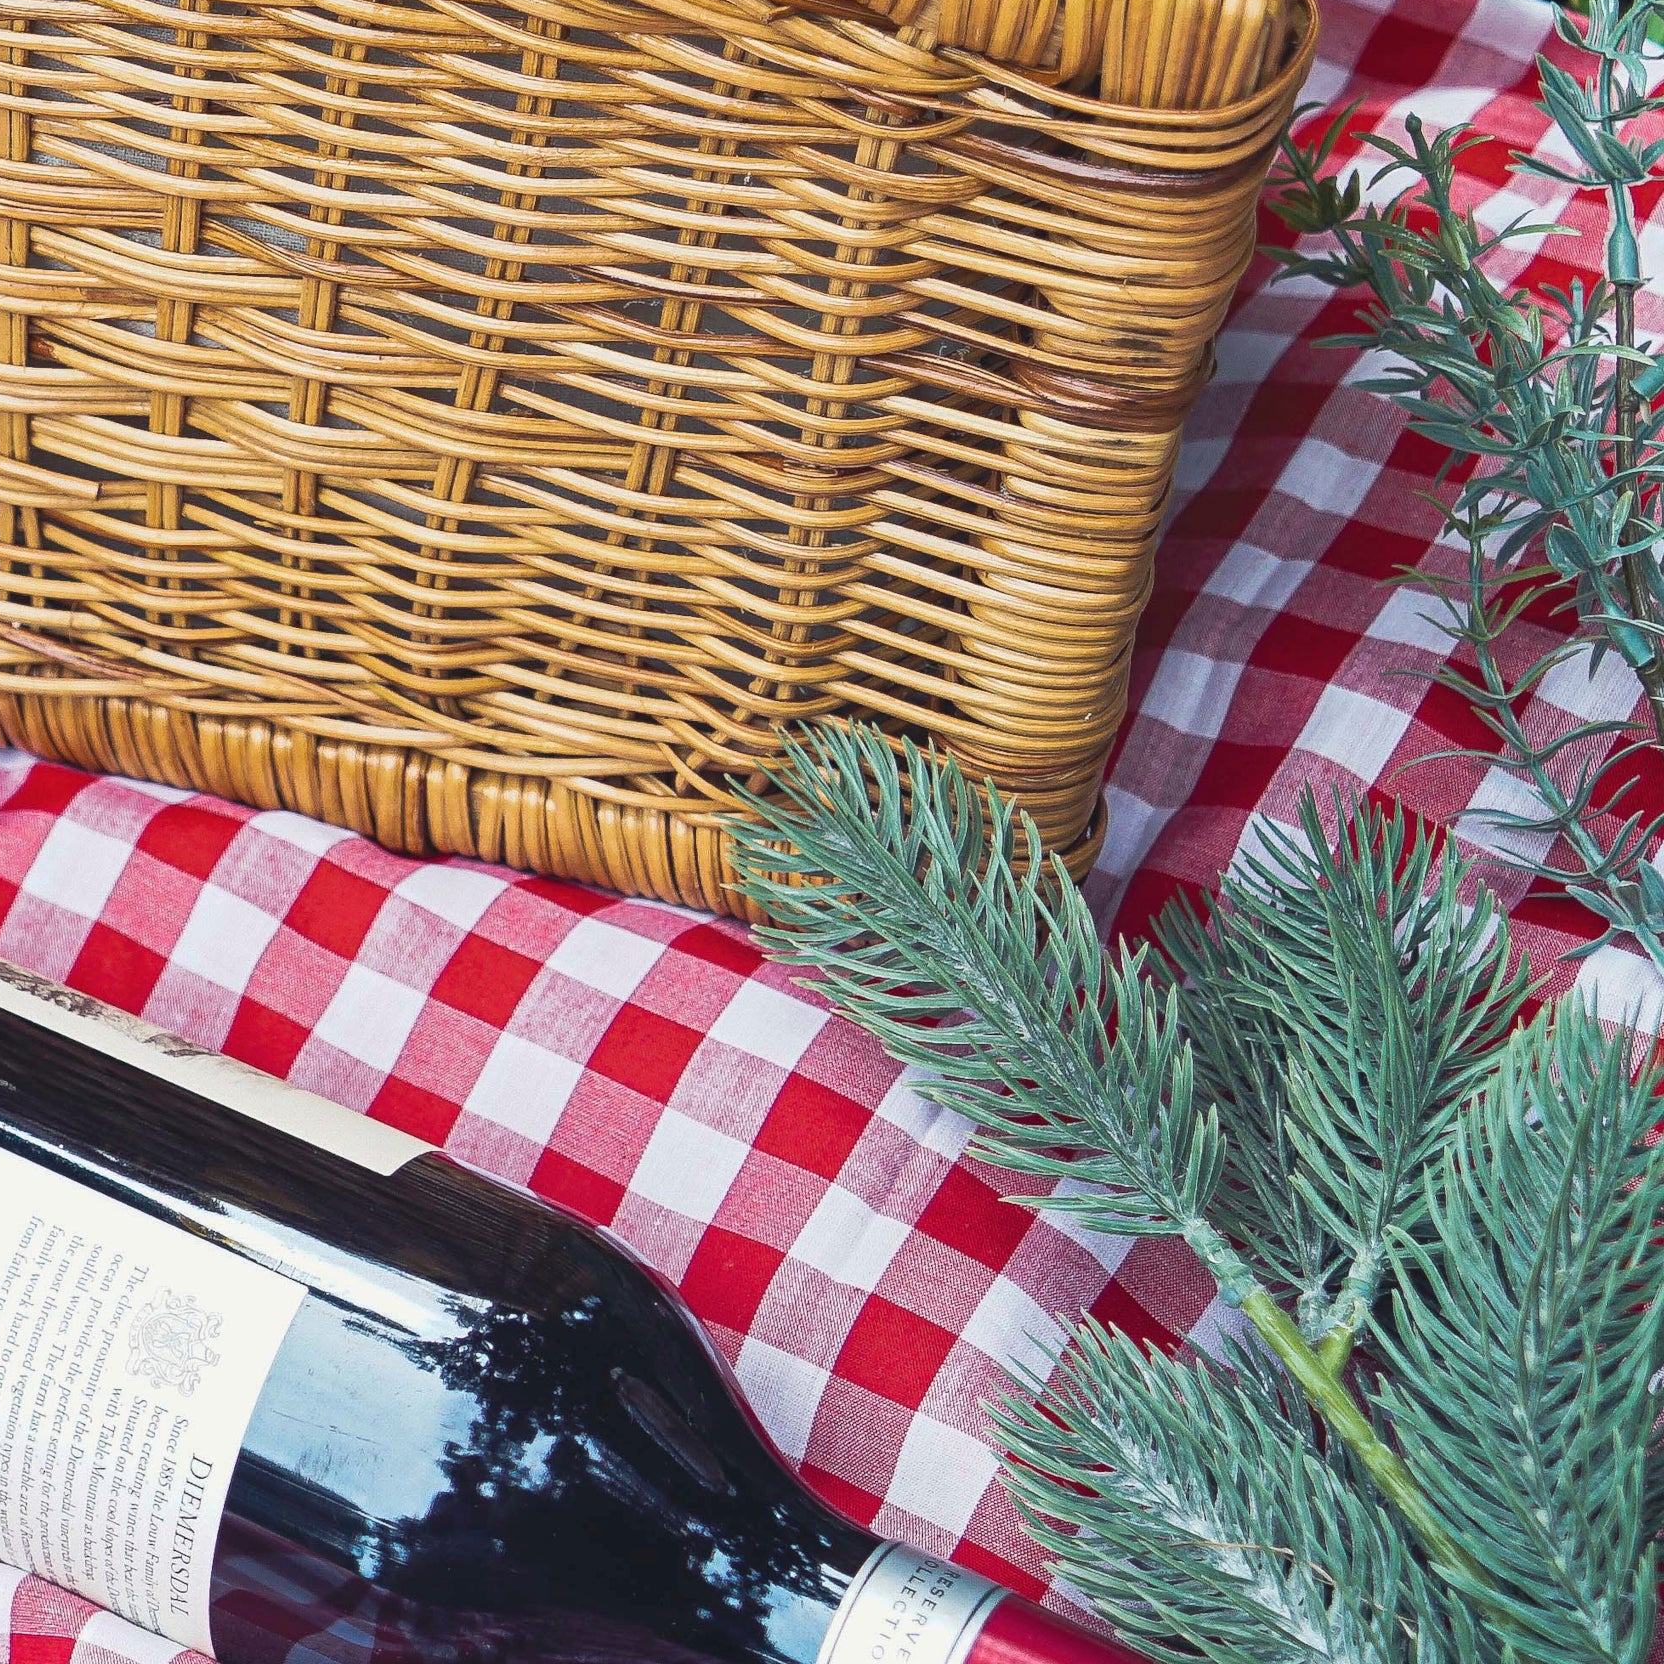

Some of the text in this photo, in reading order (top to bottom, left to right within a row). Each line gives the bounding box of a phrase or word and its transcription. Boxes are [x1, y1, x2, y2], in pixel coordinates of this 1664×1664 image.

[19, 1216, 45, 1248] from
[33, 1225, 65, 1269] family
[66, 1236, 84, 1256] the
[1, 1252, 27, 1294] father
[50, 1259, 70, 1293] most
[75, 1244, 102, 1292] soulful
[100, 1254, 123, 1291] ocean
[125, 1267, 149, 1292] The
[19, 1274, 40, 1308] work
[57, 1296, 80, 1336] wines.
[74, 1297, 103, 1358] provides
[110, 1295, 132, 1328] close
[7, 1312, 29, 1347] hard
[23, 1296, 57, 1372] threatened
[1, 1349, 13, 1362] to
[46, 1344, 66, 1371] The
[81, 1329, 114, 1401] proximity
[35, 1373, 56, 1407] farm
[65, 1362, 83, 1384] the
[5, 1375, 27, 1440] vegetation
[52, 1384, 71, 1434] perfect
[79, 1404, 92, 1423] of
[105, 1388, 123, 1418] with
[28, 1434, 36, 1442] a
[29, 1409, 47, 1433] has
[73, 1421, 90, 1442] the
[120, 1396, 147, 1456] Situated
[146, 1405, 168, 1438] been
[166, 1416, 189, 1454] Since
[39, 1436, 59, 1480] setting
[95, 1423, 117, 1460] Table
[0, 1475, 12, 1487] in
[21, 1445, 38, 1492] sizeable
[61, 1444, 84, 1517] Diemersdal
[115, 1456, 126, 1472] on
[128, 1443, 152, 1499] creating
[158, 1457, 177, 1491] 1885
[0, 1489, 12, 1507] the
[19, 1493, 28, 1516] area
[40, 1480, 56, 1500] for
[85, 1461, 107, 1522] Mountain
[111, 1476, 127, 1499] the
[153, 1490, 168, 1512] the
[40, 1500, 54, 1518] the
[106, 1499, 120, 1526] cool
[126, 1503, 142, 1538] wines
[57, 1518, 75, 1564] vineyards
[84, 1523, 93, 1538] as
[100, 1524, 120, 1558] slopes
[148, 1512, 164, 1551] Louw
[168, 1452, 214, 1616] DIEMERSDAL
[124, 1540, 139, 1563] that
[124, 1564, 139, 1587] bear
[140, 1551, 159, 1589] Family
[871, 1557, 936, 1661] OLLECTIO
[896, 1567, 962, 1663] RESERVE
